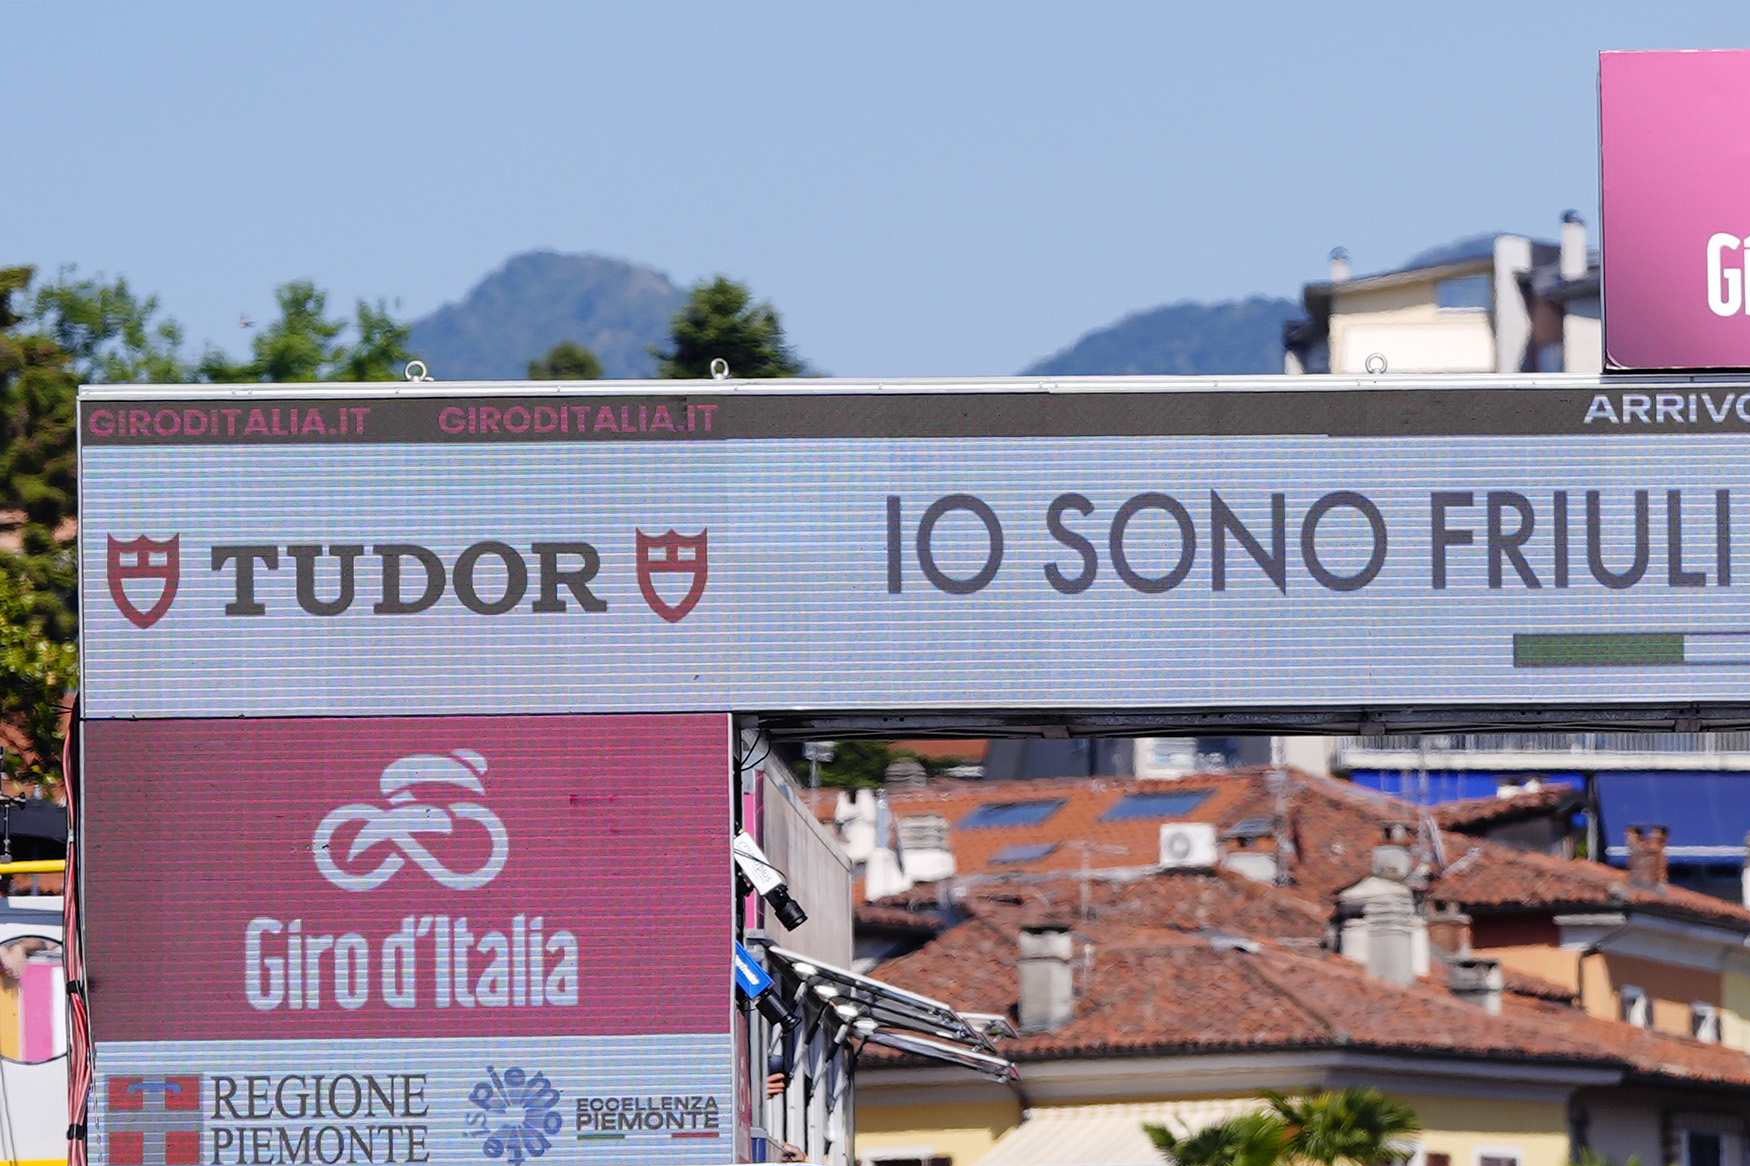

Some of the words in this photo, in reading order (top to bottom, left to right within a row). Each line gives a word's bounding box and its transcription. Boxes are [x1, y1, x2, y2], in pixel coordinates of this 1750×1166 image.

[88, 407, 372, 436] GIRODITALIA.IT
[438, 404, 719, 432] GIRODITALIA.IT
[887, 492, 1004, 595] IO
[1043, 489, 1388, 595] SONO
[1430, 490, 1731, 593] FRIULI
[211, 542, 608, 616] TUDOR
[245, 918, 370, 1011] Giro
[381, 914, 578, 1009] d'Italia
[212, 1074, 430, 1119] REGIONE
[576, 1096, 719, 1112] ECCELLENZA
[576, 1111, 720, 1131] PIEMONTE
[212, 1125, 430, 1166] PIEMONTE
